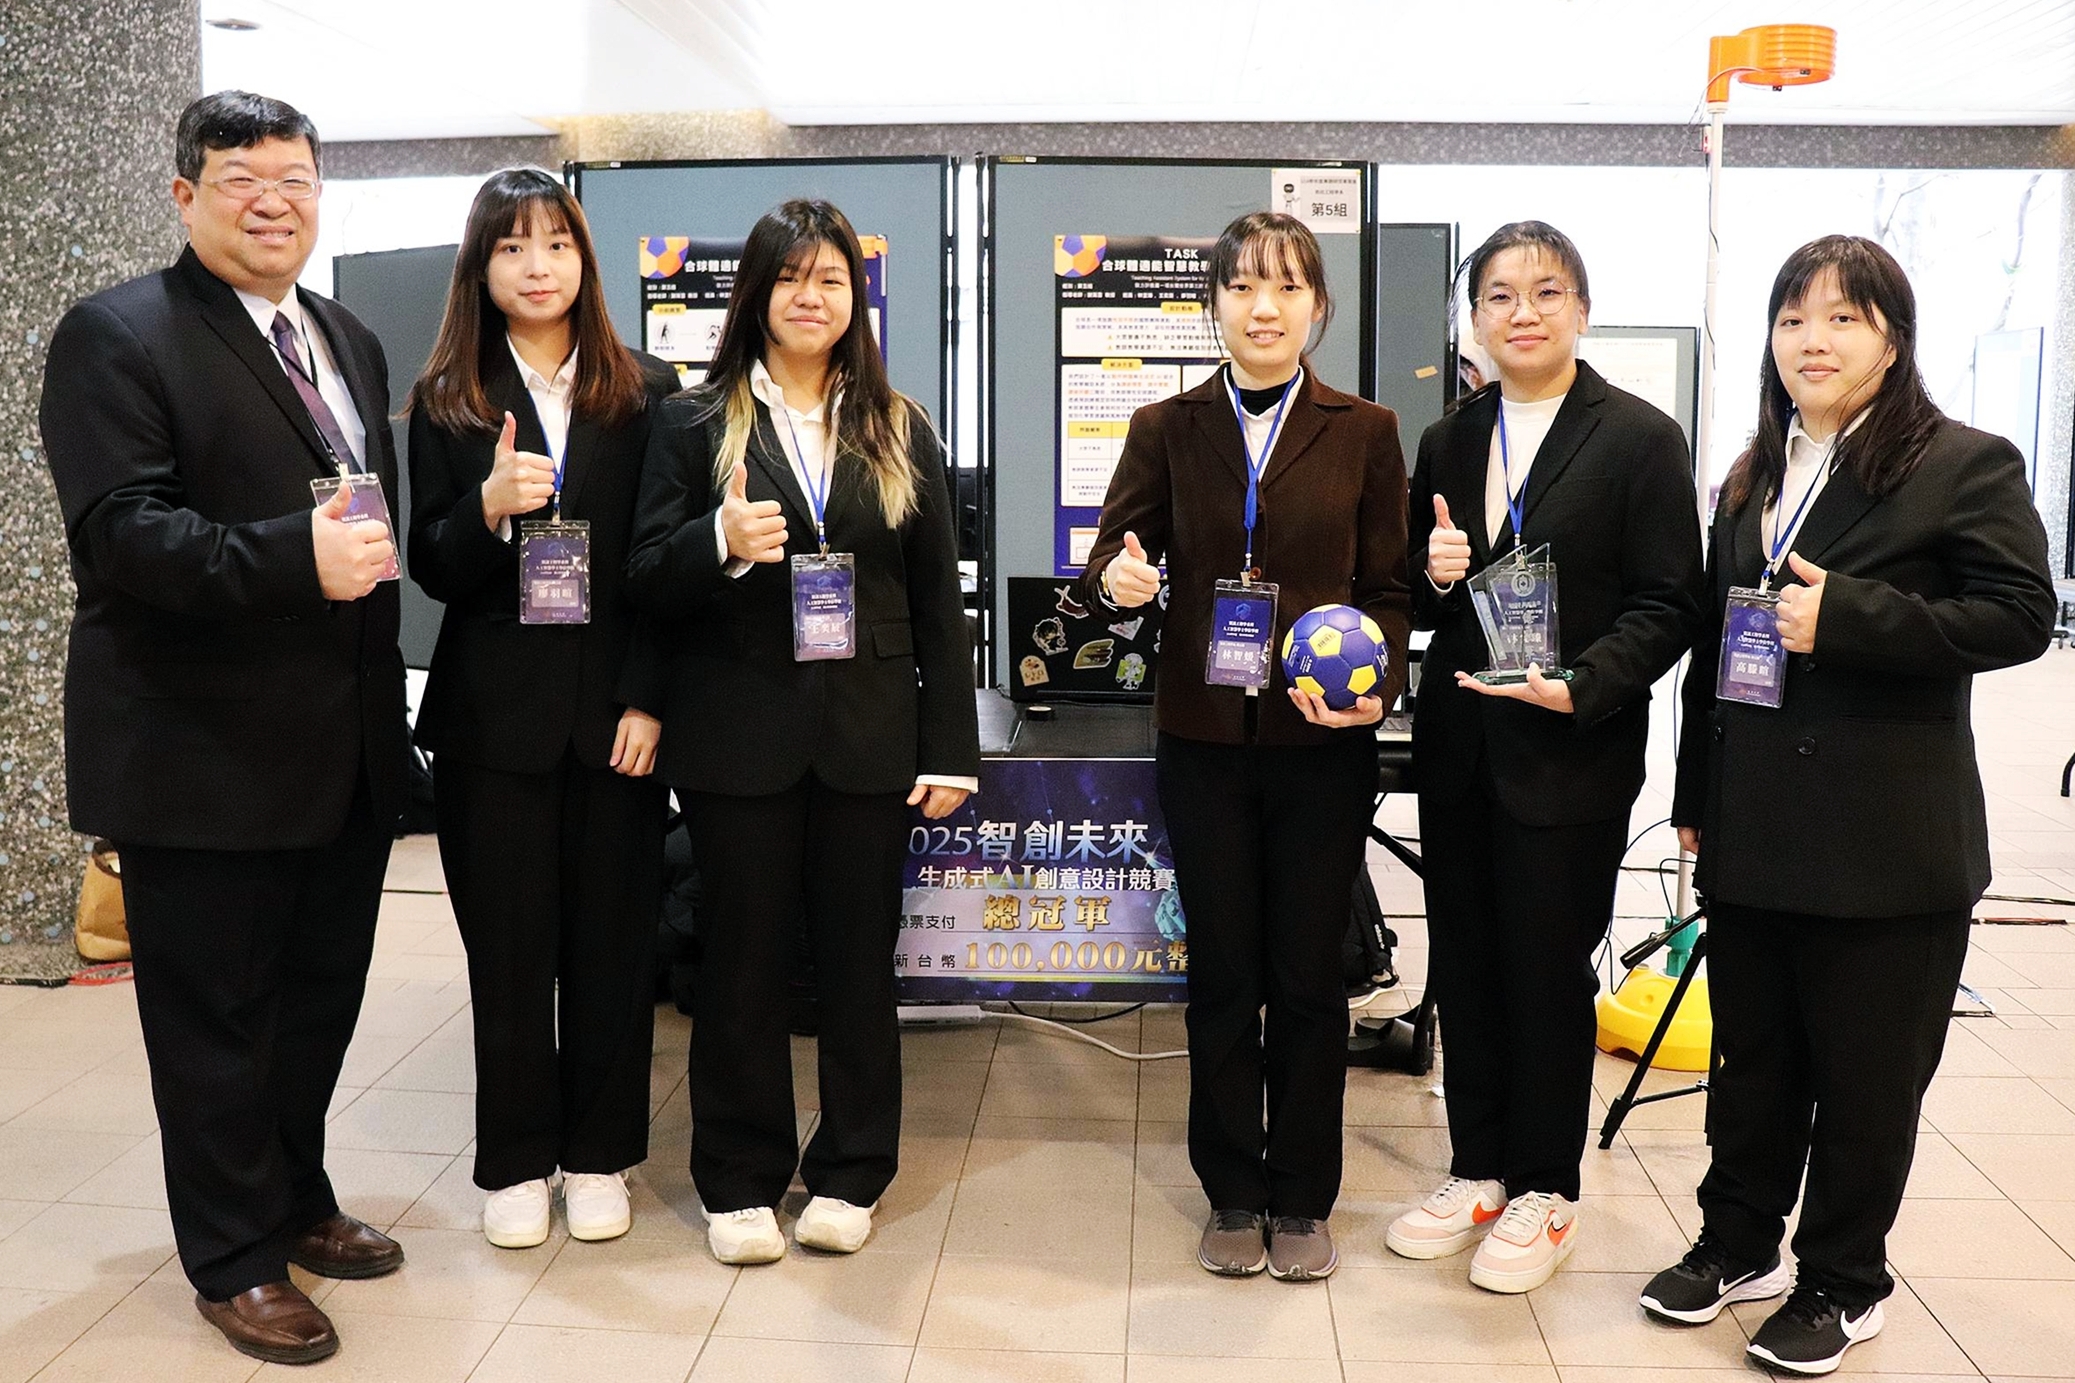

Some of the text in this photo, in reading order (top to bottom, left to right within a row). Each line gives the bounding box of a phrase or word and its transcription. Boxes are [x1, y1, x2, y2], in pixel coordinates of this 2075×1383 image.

[1311, 202, 1347, 217] 第5組
[1165, 248, 1199, 260] TASK
[908, 820, 1152, 864] 025智創未來
[917, 864, 1176, 892] 生成式AI創意設計競賽
[982, 894, 1112, 932] 總冠軍
[894, 953, 956, 968] 新台幣
